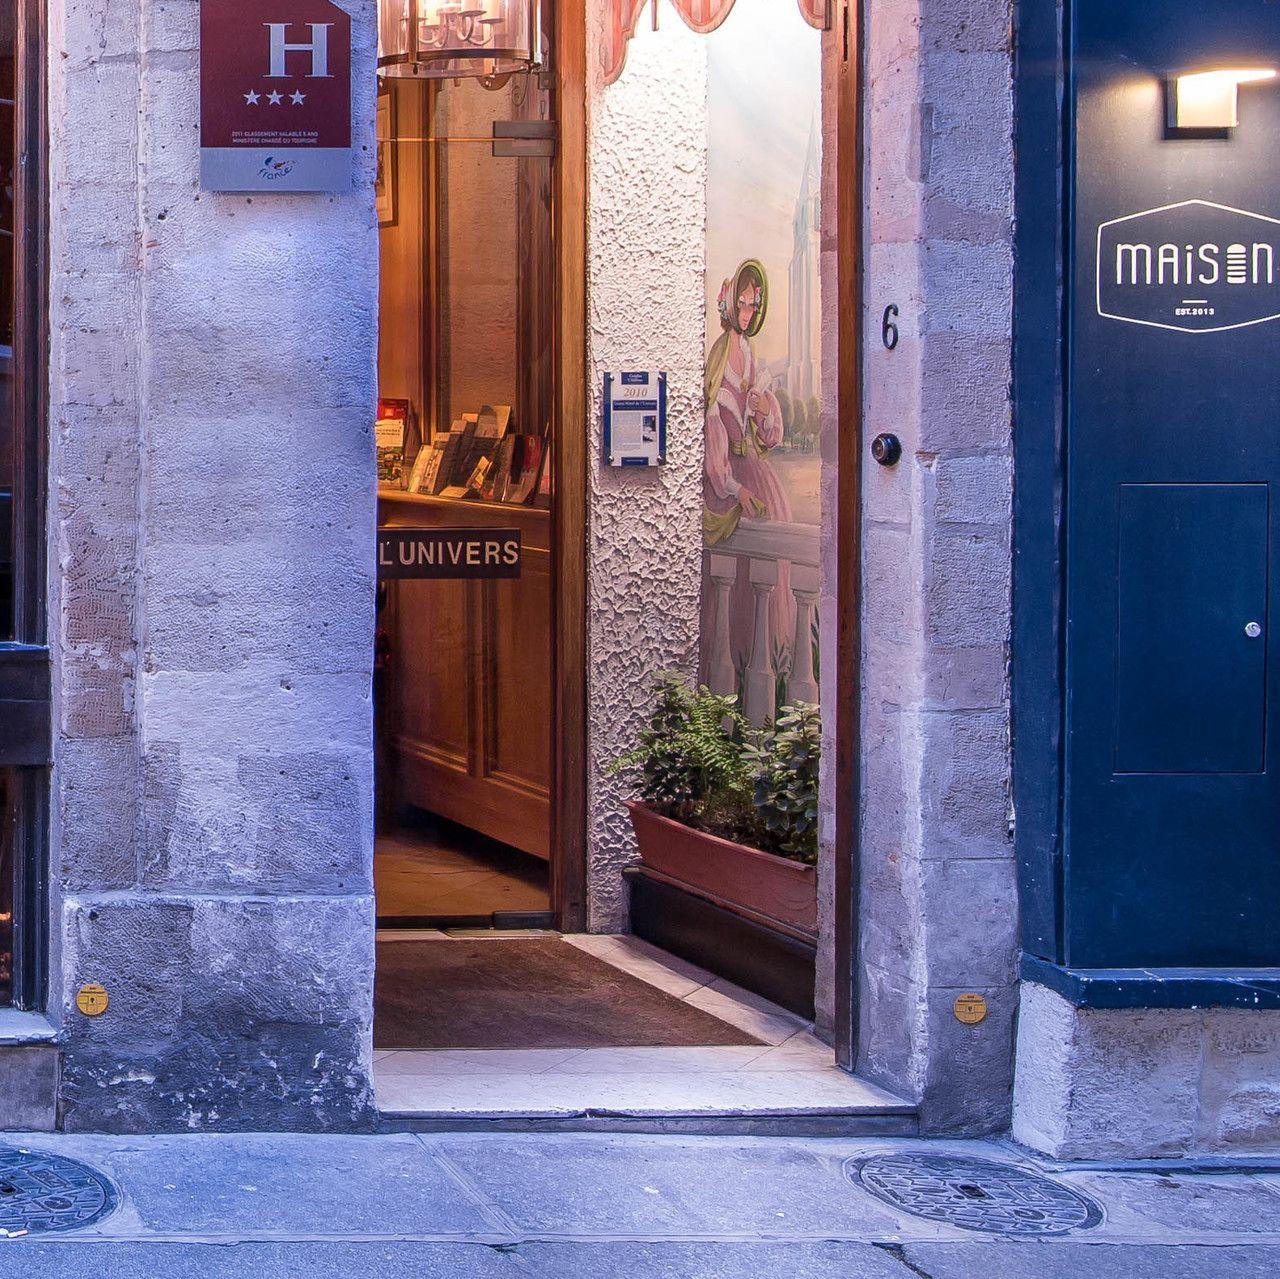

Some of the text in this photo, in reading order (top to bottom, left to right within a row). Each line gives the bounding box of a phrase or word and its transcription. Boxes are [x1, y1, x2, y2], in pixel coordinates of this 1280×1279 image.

[262, 22, 335, 78] H
[882, 304, 899, 350] 6
[624, 388, 648, 397] 2010
